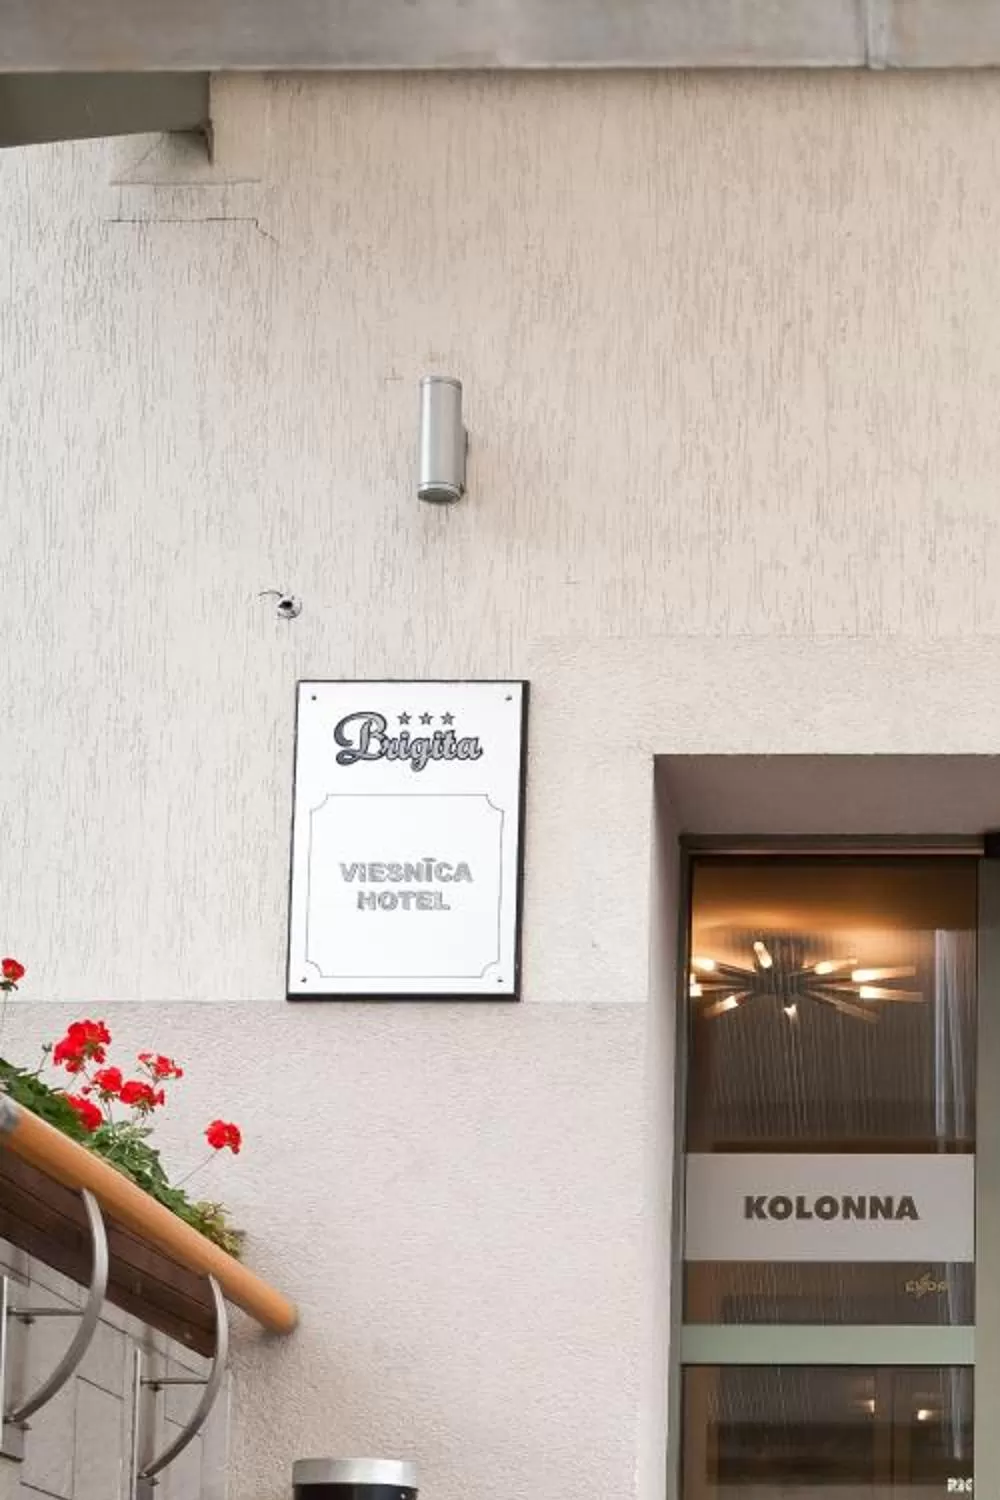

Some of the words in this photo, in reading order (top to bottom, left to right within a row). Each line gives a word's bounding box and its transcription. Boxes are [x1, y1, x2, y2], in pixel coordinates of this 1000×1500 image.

[333, 711, 484, 772] Brigita
[339, 857, 474, 883] VIESNĪCA
[356, 890, 452, 912] HOTEL
[743, 1195, 920, 1221] KOLONNA
